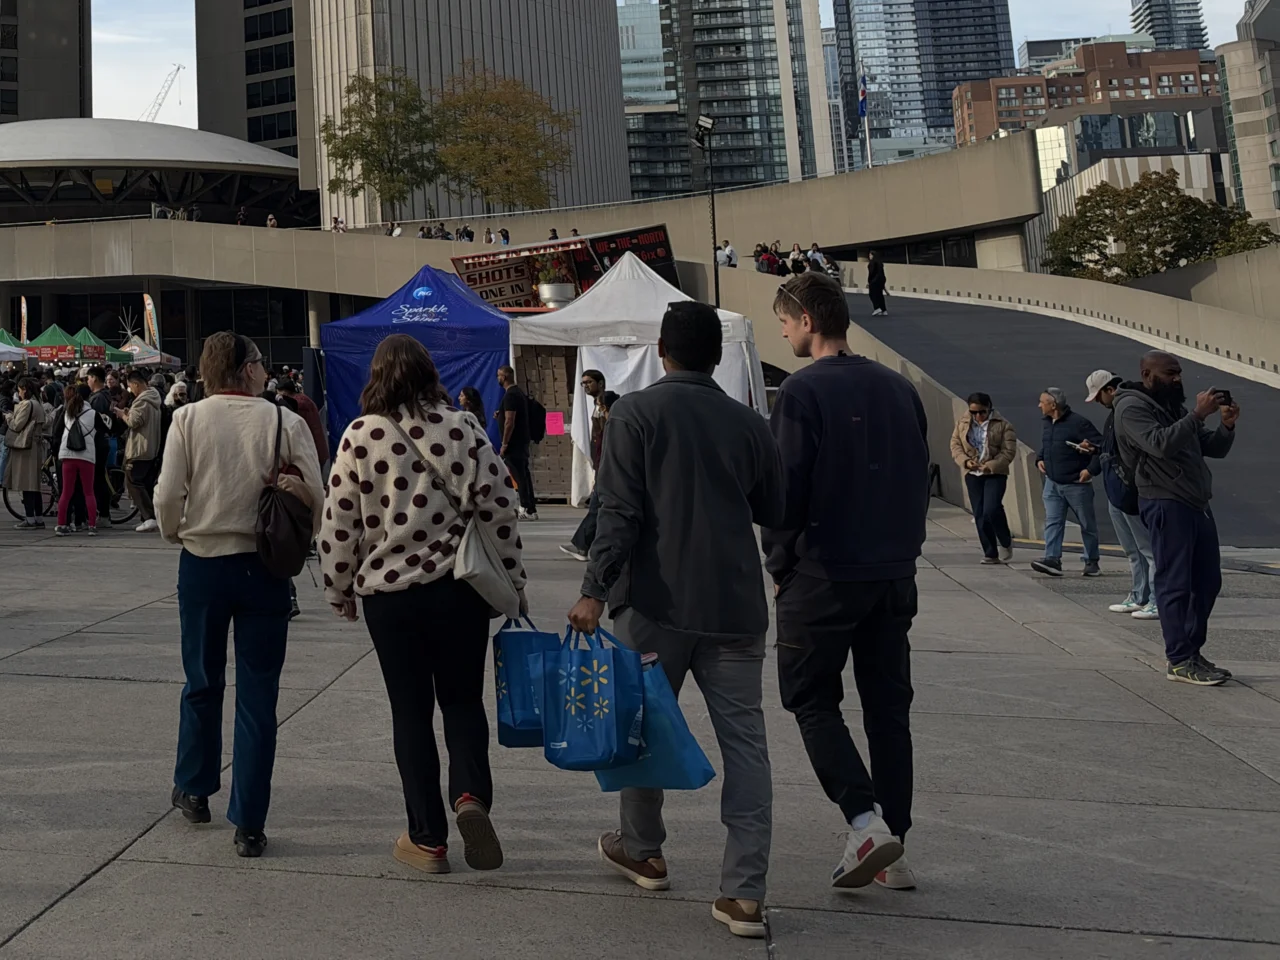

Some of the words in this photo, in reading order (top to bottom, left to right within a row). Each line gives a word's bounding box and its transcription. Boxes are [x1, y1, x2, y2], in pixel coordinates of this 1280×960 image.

[595, 241, 611, 254] WE
[616, 237, 632, 250] THE
[637, 231, 666, 245] NORTH
[466, 264, 525, 286] SHOTS
[480, 286, 506, 300] ONE
[510, 283, 525, 295] IN
[391, 303, 449, 317] Sparkle
